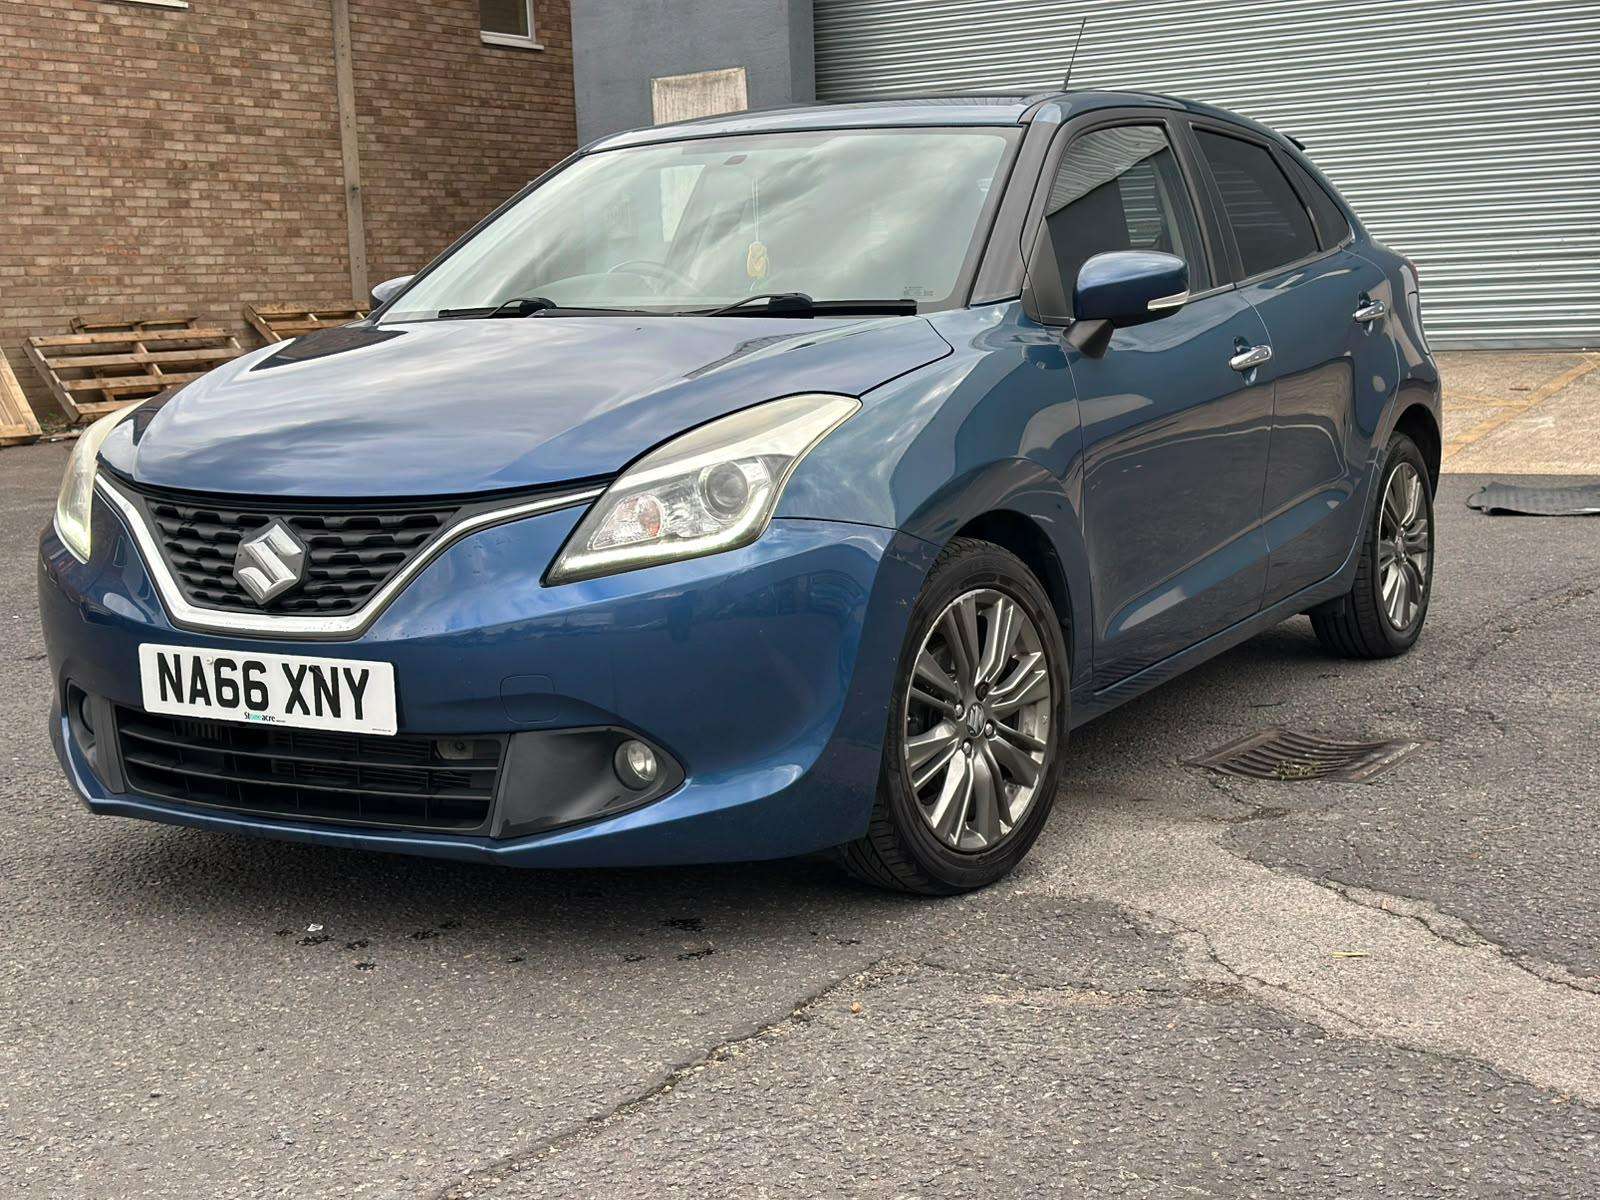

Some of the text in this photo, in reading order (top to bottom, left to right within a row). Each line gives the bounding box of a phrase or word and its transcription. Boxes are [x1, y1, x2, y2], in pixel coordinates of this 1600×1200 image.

[156, 652, 370, 720] NA66 XNY
[244, 711, 276, 722] Stacre
